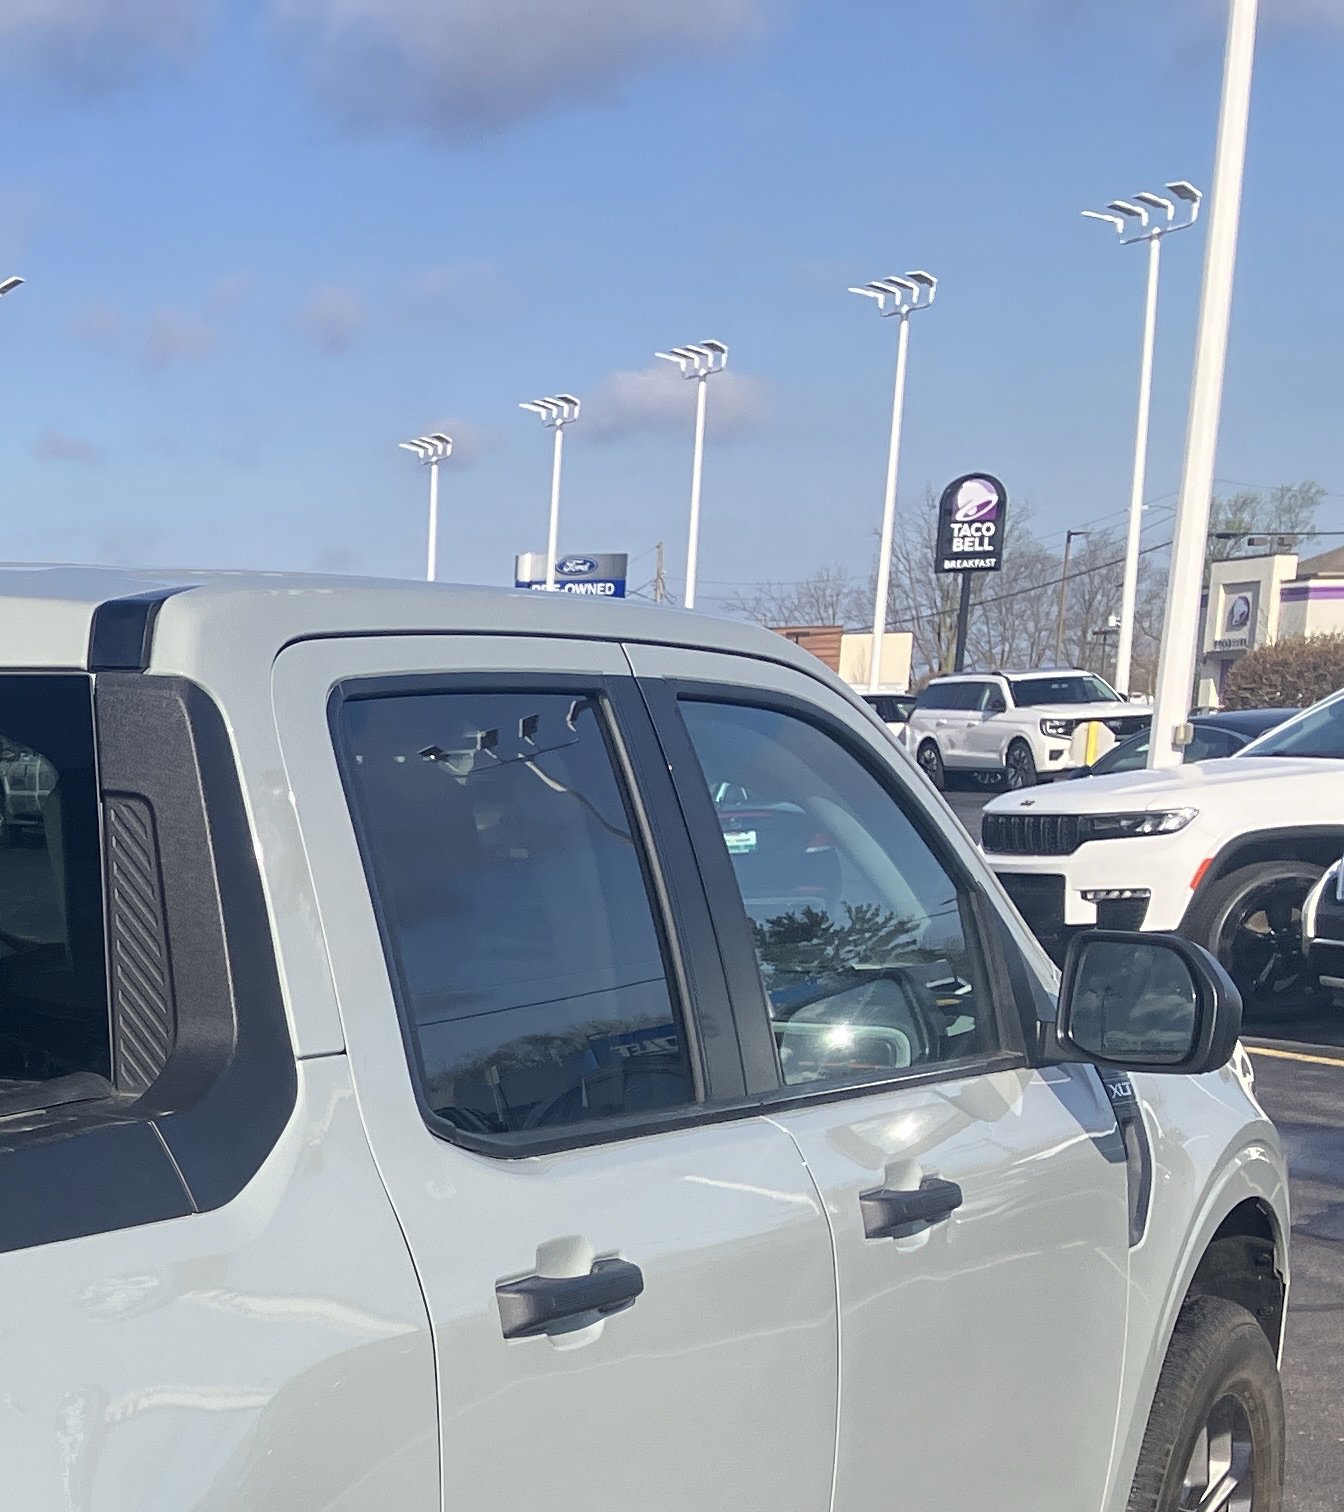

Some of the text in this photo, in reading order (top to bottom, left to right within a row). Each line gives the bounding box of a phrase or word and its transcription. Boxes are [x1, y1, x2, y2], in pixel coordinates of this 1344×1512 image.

[950, 521, 996, 538] TACO
[952, 537, 994, 553] BELL
[562, 559, 592, 573] Ford
[943, 558, 997, 570] BREAKFAST
[1106, 1081, 1132, 1099] XLT
